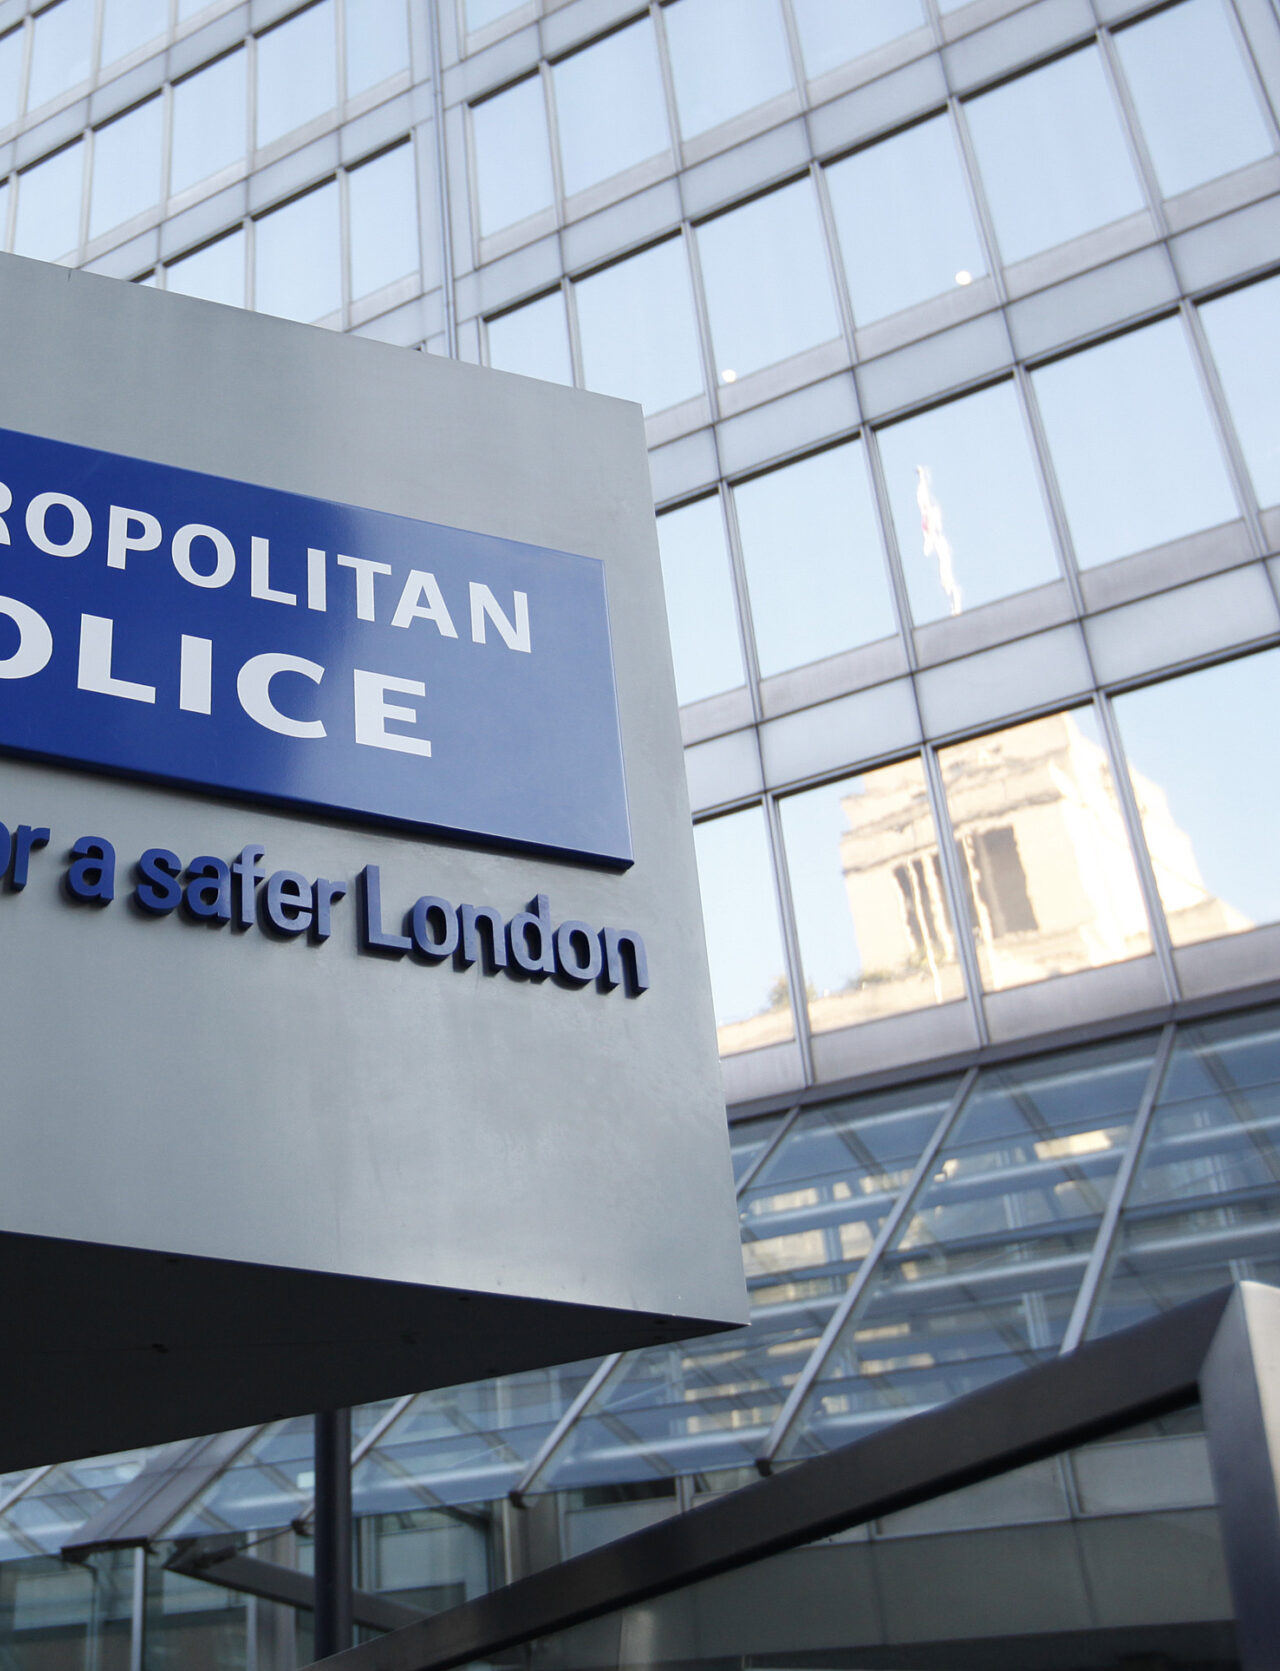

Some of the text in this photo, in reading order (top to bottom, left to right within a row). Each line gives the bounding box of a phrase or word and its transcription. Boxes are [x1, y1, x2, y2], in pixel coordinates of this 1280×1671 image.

[66, 834, 117, 906] a
[134, 844, 347, 941] safer
[362, 864, 650, 997] London
